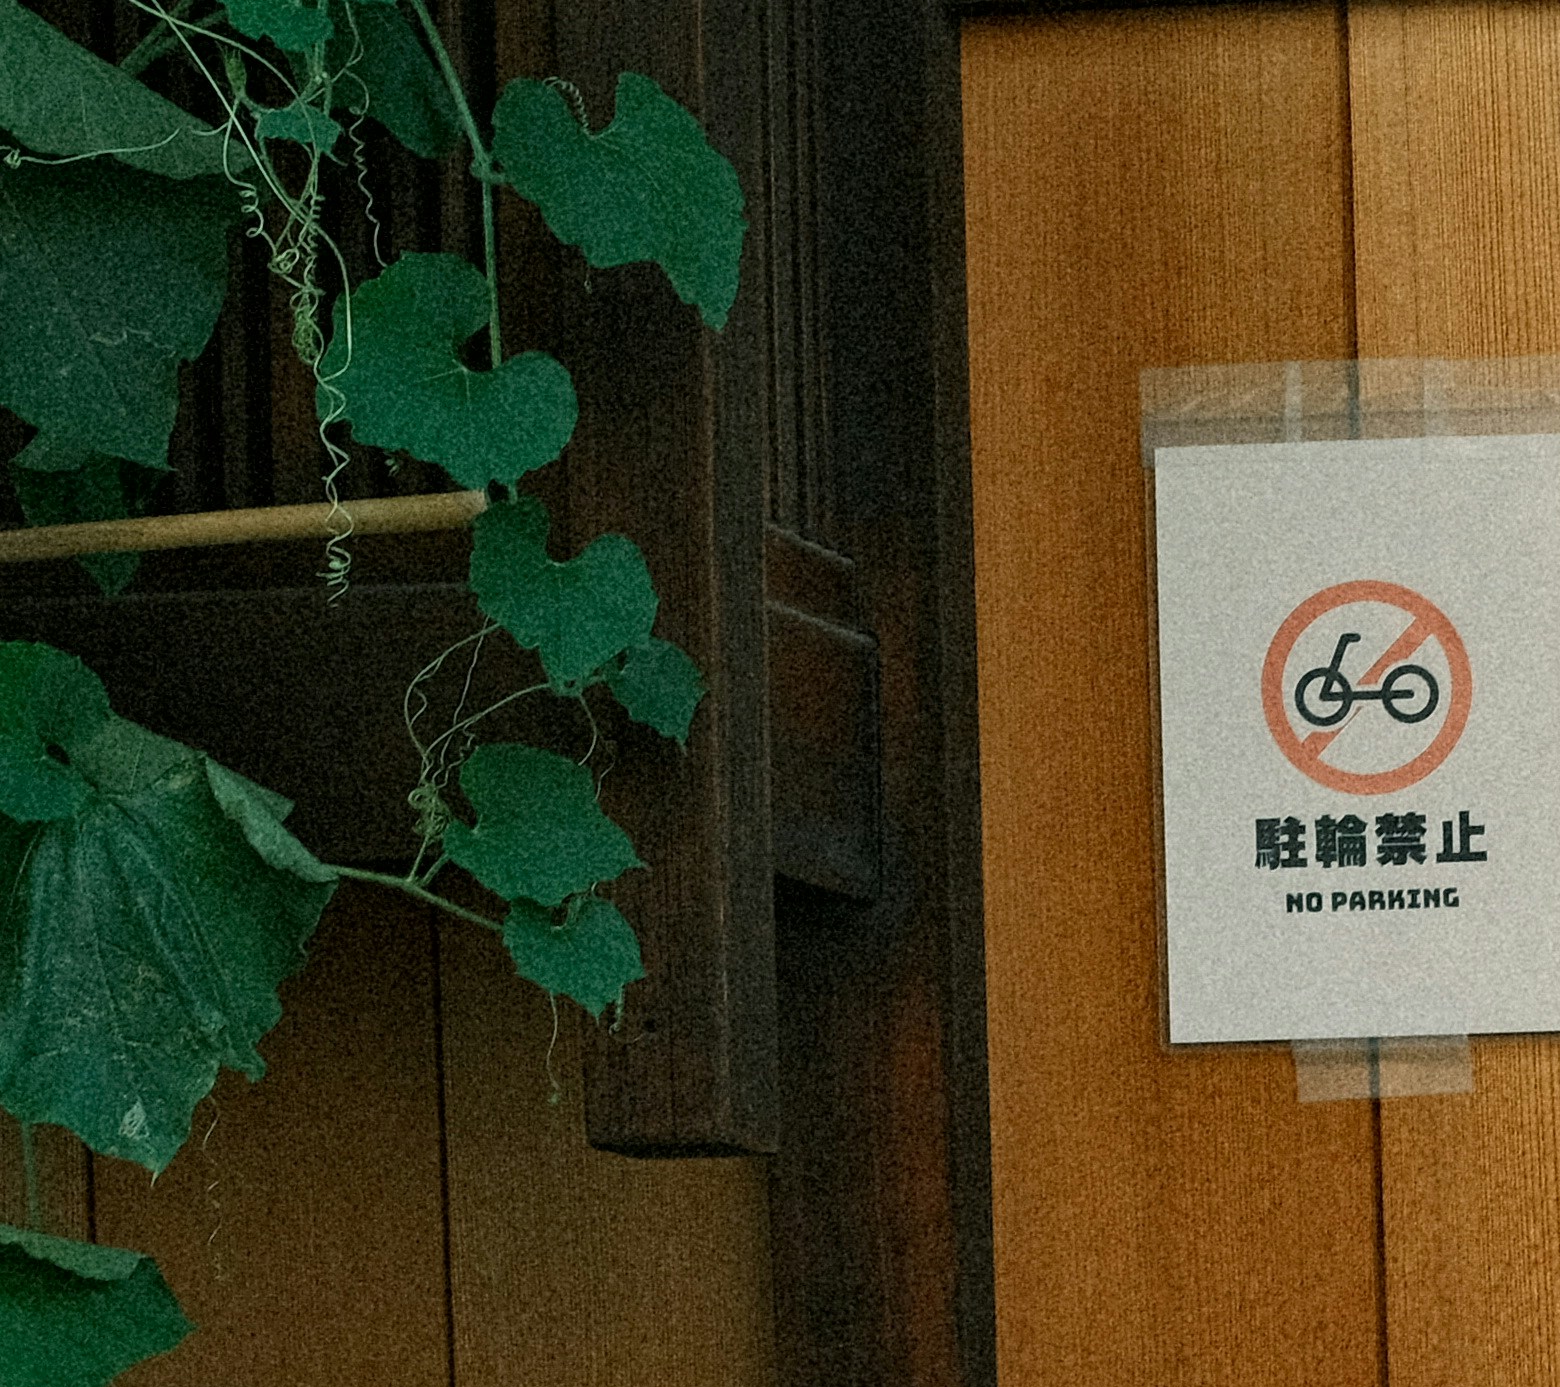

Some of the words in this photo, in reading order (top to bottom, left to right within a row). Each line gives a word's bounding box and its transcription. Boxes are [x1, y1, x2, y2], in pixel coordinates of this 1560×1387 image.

[1254, 810, 1488, 871] 駐輪禁止
[1286, 891, 1323, 913] NO
[1331, 887, 1460, 912] PARKING
